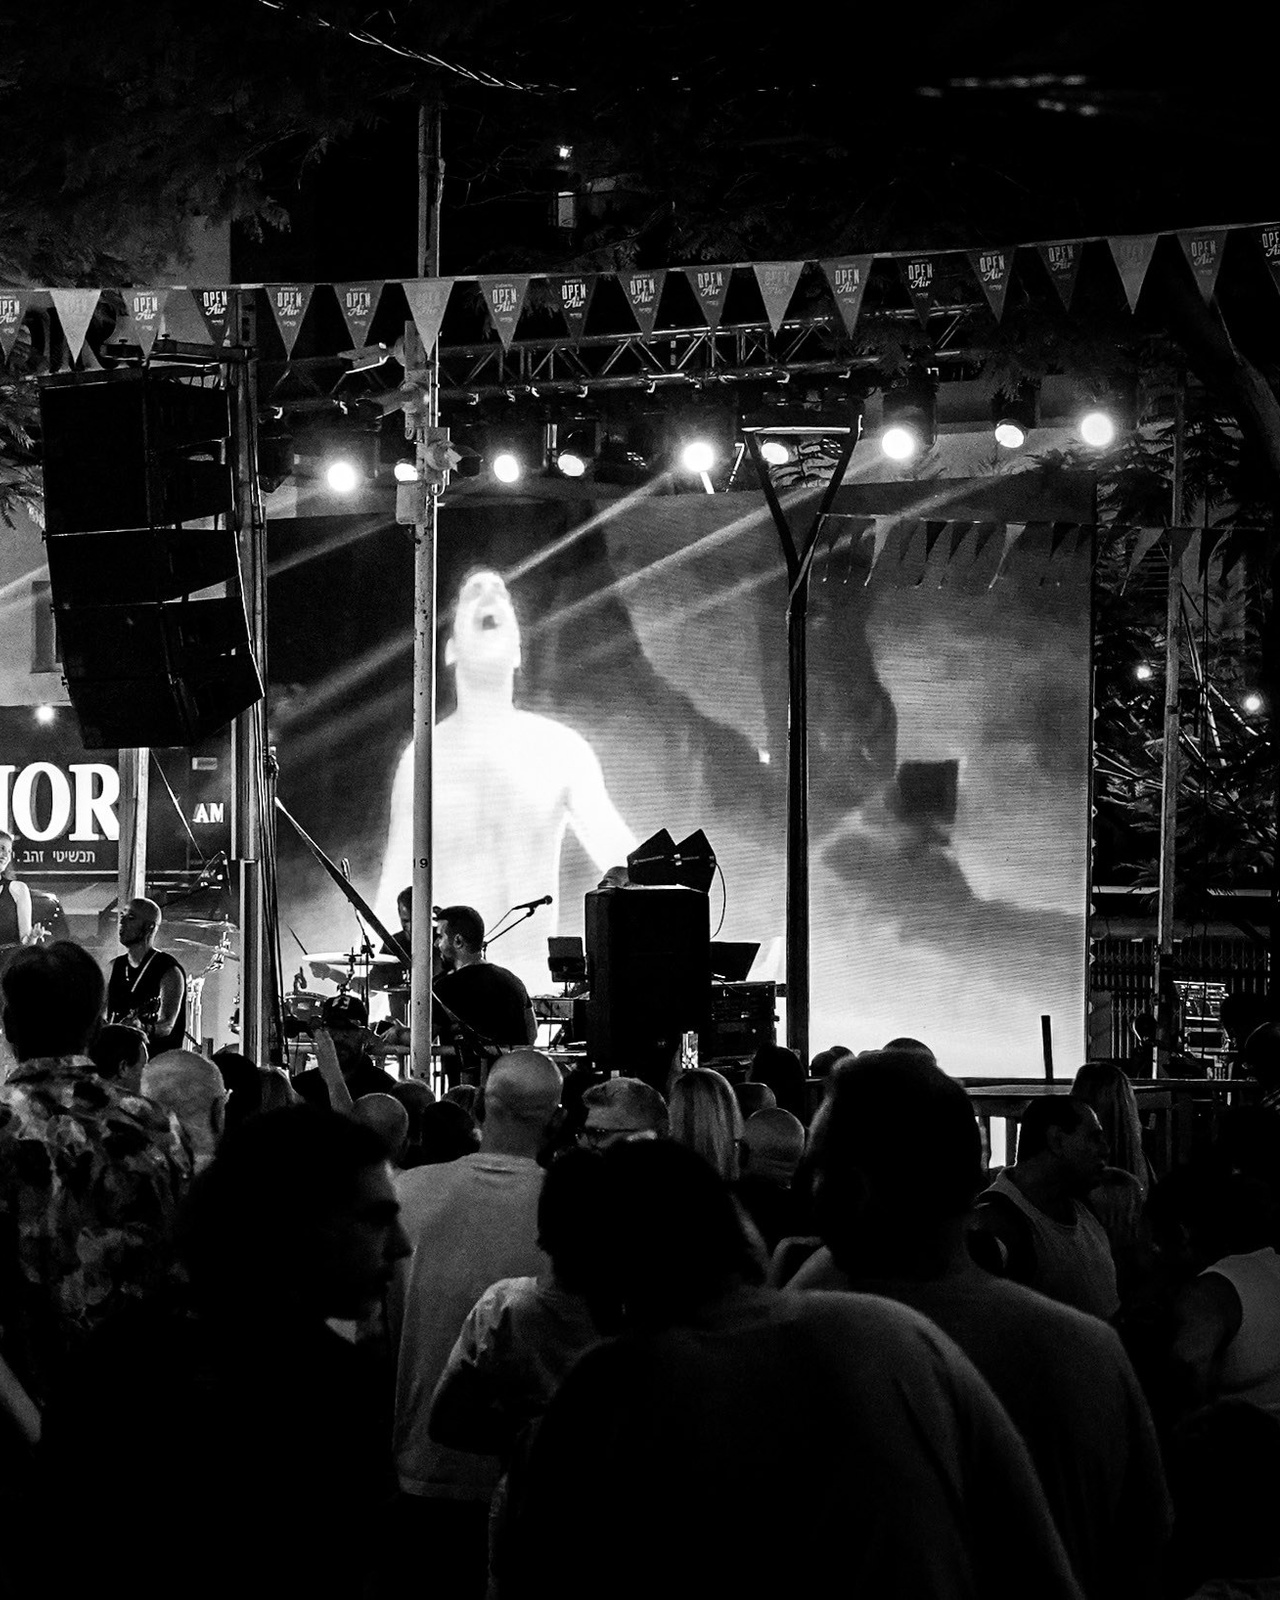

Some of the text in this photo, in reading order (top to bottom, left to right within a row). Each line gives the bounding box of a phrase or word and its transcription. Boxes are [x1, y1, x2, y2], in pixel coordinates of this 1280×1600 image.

[1262, 231, 1280, 248] OPE
[1048, 245, 1074, 262] OPEN
[1191, 241, 1216, 256] OPEN
[979, 255, 1005, 273] OPEN
[1051, 257, 1072, 271] Air
[1193, 252, 1215, 266] Air
[835, 268, 860, 285] OPEN
[908, 263, 933, 280] OPEN
[983, 268, 1004, 282] Air
[630, 278, 655, 295] OPEN
[697, 272, 723, 287] OPEN
[910, 275, 932, 289] Air
[561, 284, 587, 300] OPEN
[700, 283, 720, 297] Air
[836, 280, 858, 294] Air
[203, 291, 227, 306] OPEN
[277, 292, 302, 308] OPEN
[346, 292, 371, 308] OPEN
[492, 289, 517, 305] OPEN
[563, 297, 585, 310] Air
[632, 290, 654, 304] Air
[133, 297, 158, 313] OPEN
[205, 303, 226, 316] Air
[278, 303, 300, 317] Air
[348, 304, 369, 317] Air
[494, 300, 515, 313] Air
[135, 308, 156, 321] Air
[53, 850, 96, 863] תכשיטי
